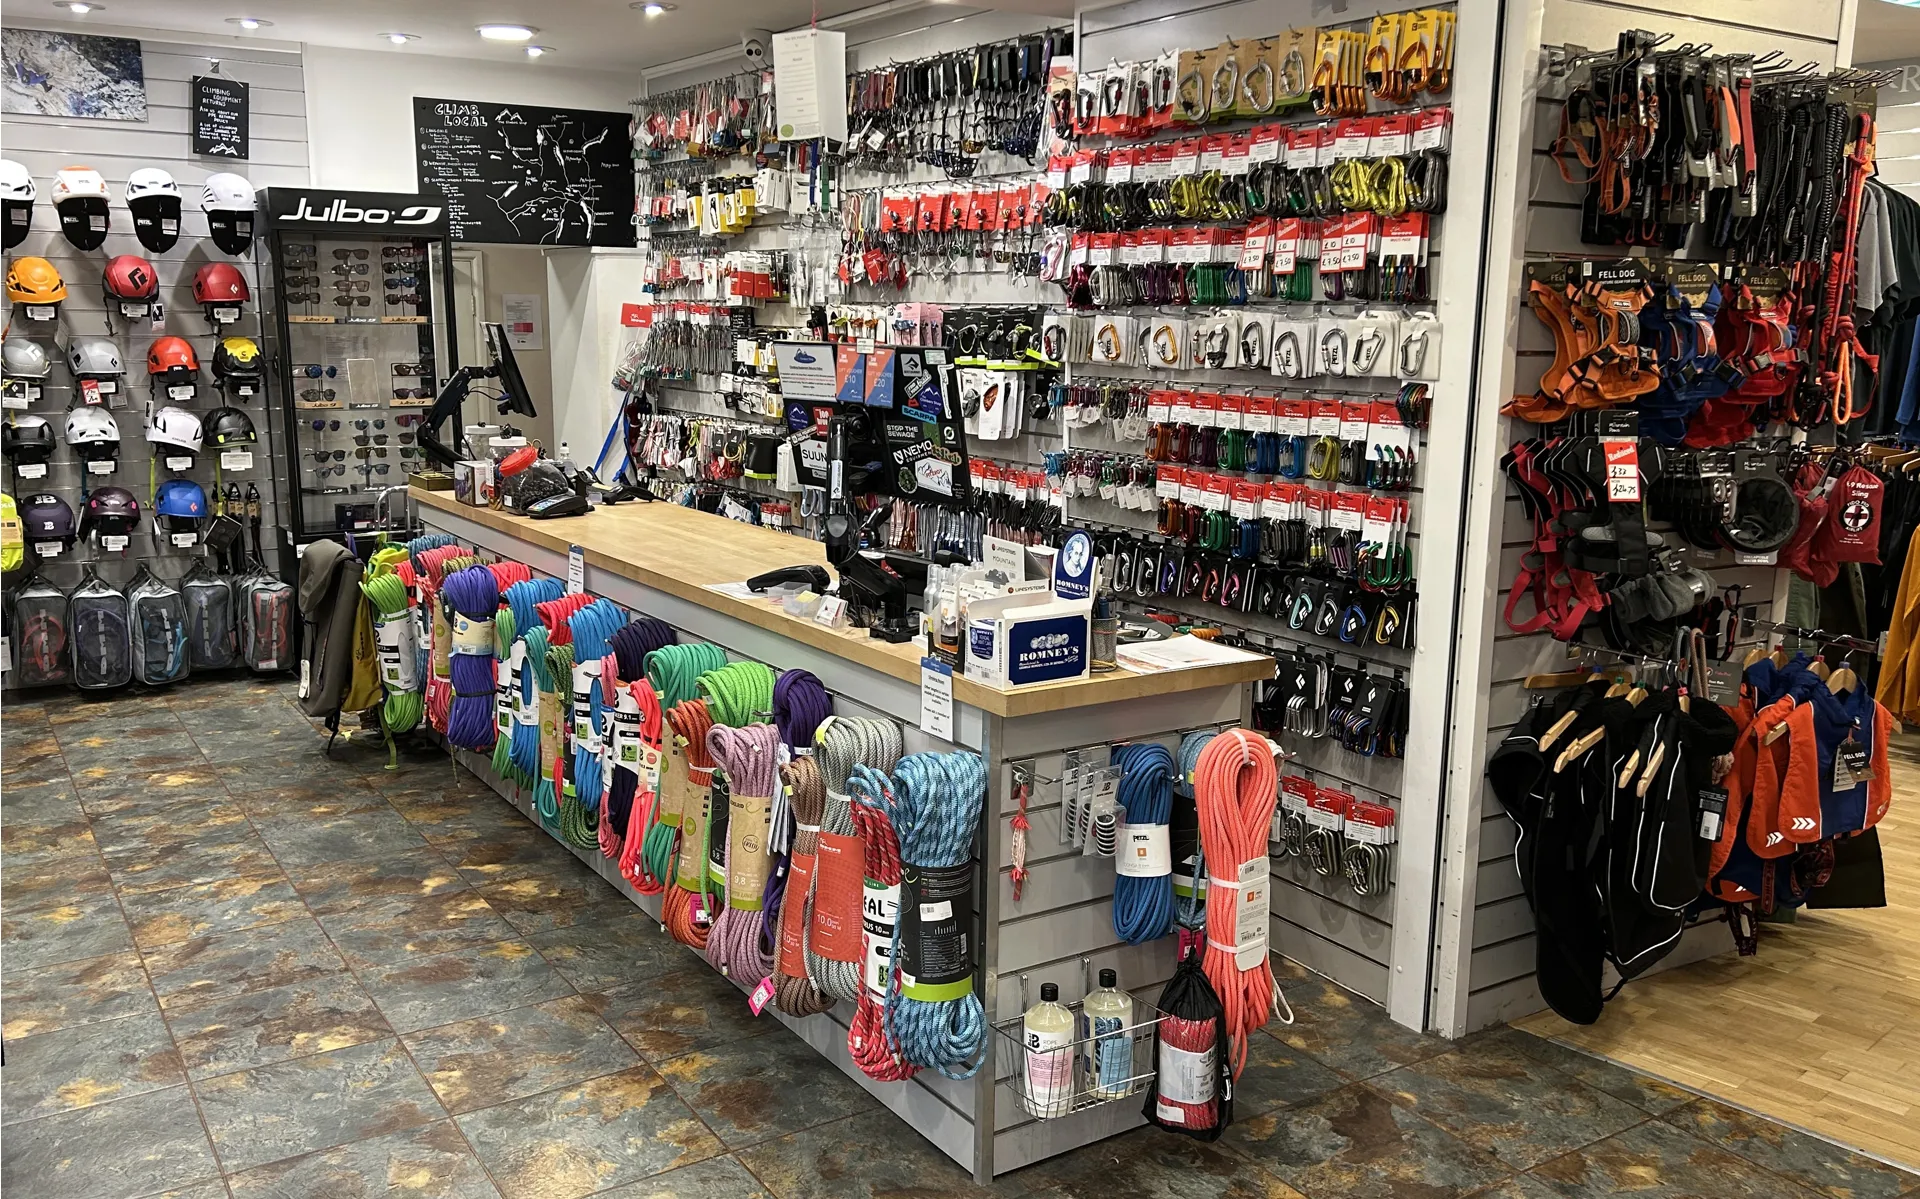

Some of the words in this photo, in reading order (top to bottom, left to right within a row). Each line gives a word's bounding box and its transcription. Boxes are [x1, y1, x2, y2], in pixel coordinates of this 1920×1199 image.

[202, 85, 231, 96] CLIMBING
[434, 103, 480, 117] CLIMB
[443, 115, 488, 127] LOCAL
[278, 197, 390, 224] Julbo
[1248, 218, 1270, 235] Reduced
[1277, 221, 1298, 238] Reduced
[1323, 221, 1344, 236] Reduce
[1344, 214, 1368, 233] Reduced
[1246, 239, 1257, 247] £10
[1277, 242, 1288, 251] £10
[1324, 240, 1337, 250] £10
[1344, 237, 1356, 246] £10
[1243, 254, 1260, 265] £7.50
[1275, 257, 1292, 269] £7.50
[1321, 256, 1341, 267] £7.50
[1342, 253, 1360, 265] £7.50
[1598, 270, 1618, 279] FELL
[1618, 269, 1636, 278] DOG
[1677, 274, 1692, 282] FELL
[1692, 274, 1707, 282] DOG
[1750, 277, 1765, 285] FELL
[1764, 277, 1778, 285] DOG
[1284, 346, 1292, 367] PETZL
[1331, 344, 1339, 365] PETZL
[844, 374, 856, 384] £10
[873, 378, 886, 388] £20
[903, 407, 936, 423] SCARPA
[886, 424, 904, 432] STOP
[904, 425, 919, 433] THE
[887, 430, 916, 439] SEWAGE
[902, 440, 933, 458] NEMO
[1607, 445, 1635, 462] Reduced
[802, 449, 828, 463] SUUN
[905, 451, 933, 463] EQUIPMEN
[1851, 489, 1870, 499] Sling
[992, 555, 1016, 567] MOUNTAIN
[1014, 584, 1046, 593] LIFESYSTEMS
[1056, 579, 1089, 592] ROMNEY'S
[1019, 646, 1079, 662] ROMNEY'S
[1132, 835, 1150, 843] PETZL
[734, 875, 746, 886] 9,8
[816, 913, 832, 928] 10,0
[875, 923, 883, 932] 10
